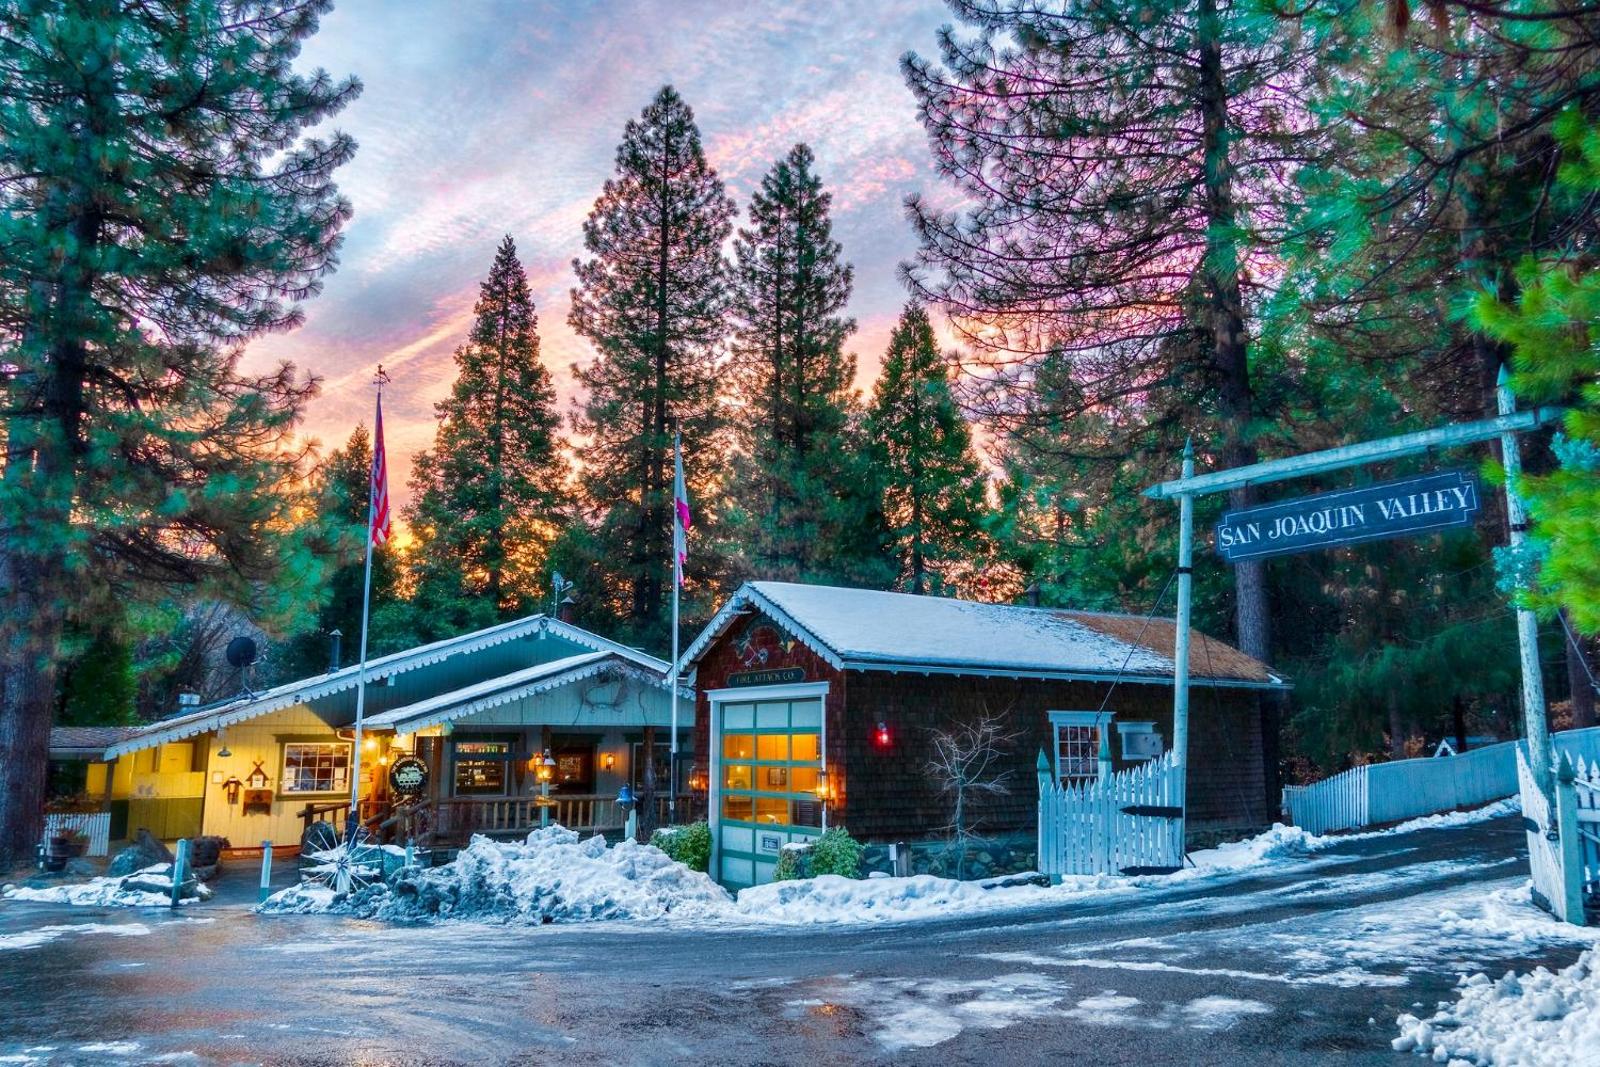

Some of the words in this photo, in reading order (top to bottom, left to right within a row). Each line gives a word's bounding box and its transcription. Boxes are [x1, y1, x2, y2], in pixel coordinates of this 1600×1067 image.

[1220, 522, 1261, 547] SAN
[1268, 503, 1364, 539] JOAQUIN
[1376, 485, 1471, 520] VALLEY
